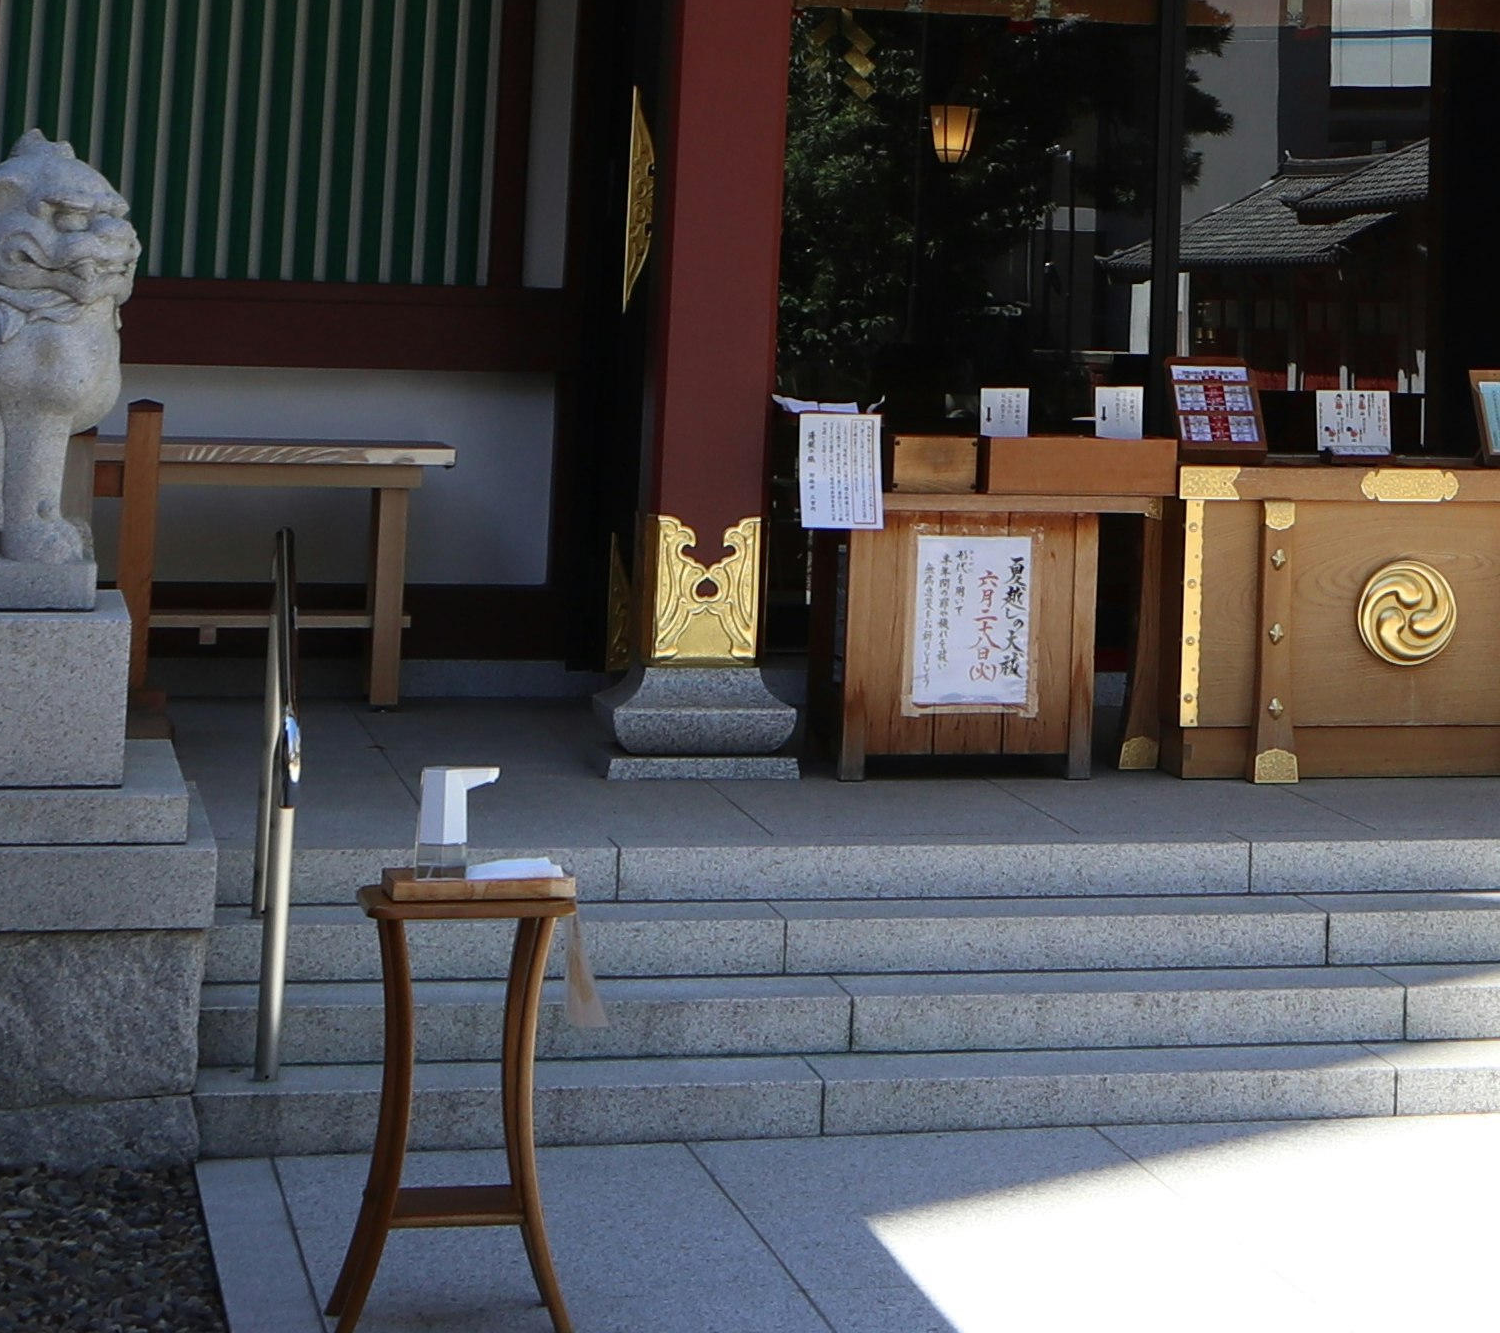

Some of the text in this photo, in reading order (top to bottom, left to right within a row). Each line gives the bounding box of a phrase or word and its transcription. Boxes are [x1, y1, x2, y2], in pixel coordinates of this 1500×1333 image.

[969, 570, 1001, 681] 六月二十八日(火)
[999, 557, 1027, 678] 夏越しの大祓
